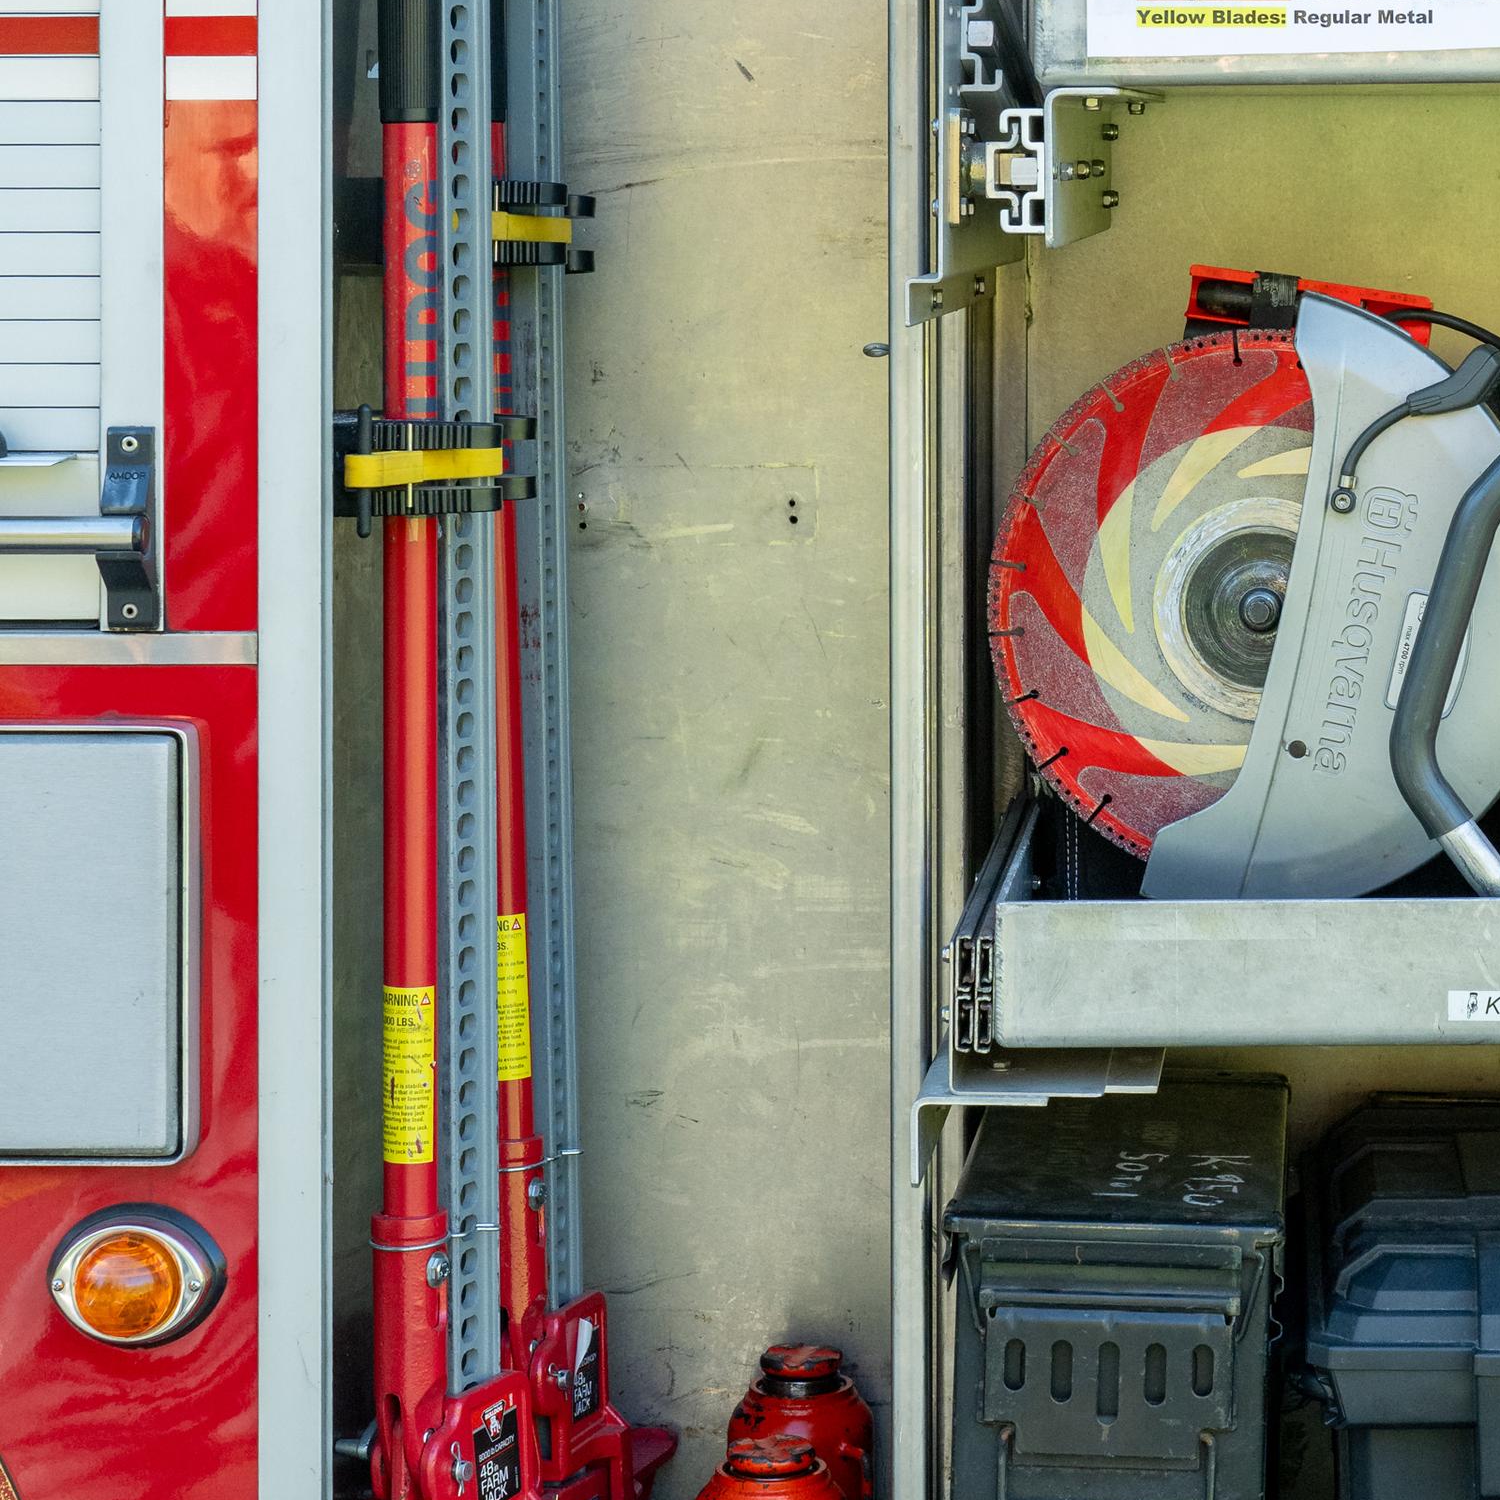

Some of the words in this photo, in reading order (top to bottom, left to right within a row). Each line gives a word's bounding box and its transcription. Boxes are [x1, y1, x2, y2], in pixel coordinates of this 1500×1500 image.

[1137, 9, 1206, 24] Yellow
[1212, 9, 1286, 25] Blades:
[1294, 9, 1372, 28] Regular
[1378, 9, 1433, 24] Metal
[1313, 536, 1401, 773] Husqvarna
[1400, 642, 1410, 660] 4700
[384, 992, 418, 1006] ARNING
[481, 1466, 509, 1495] FARM
